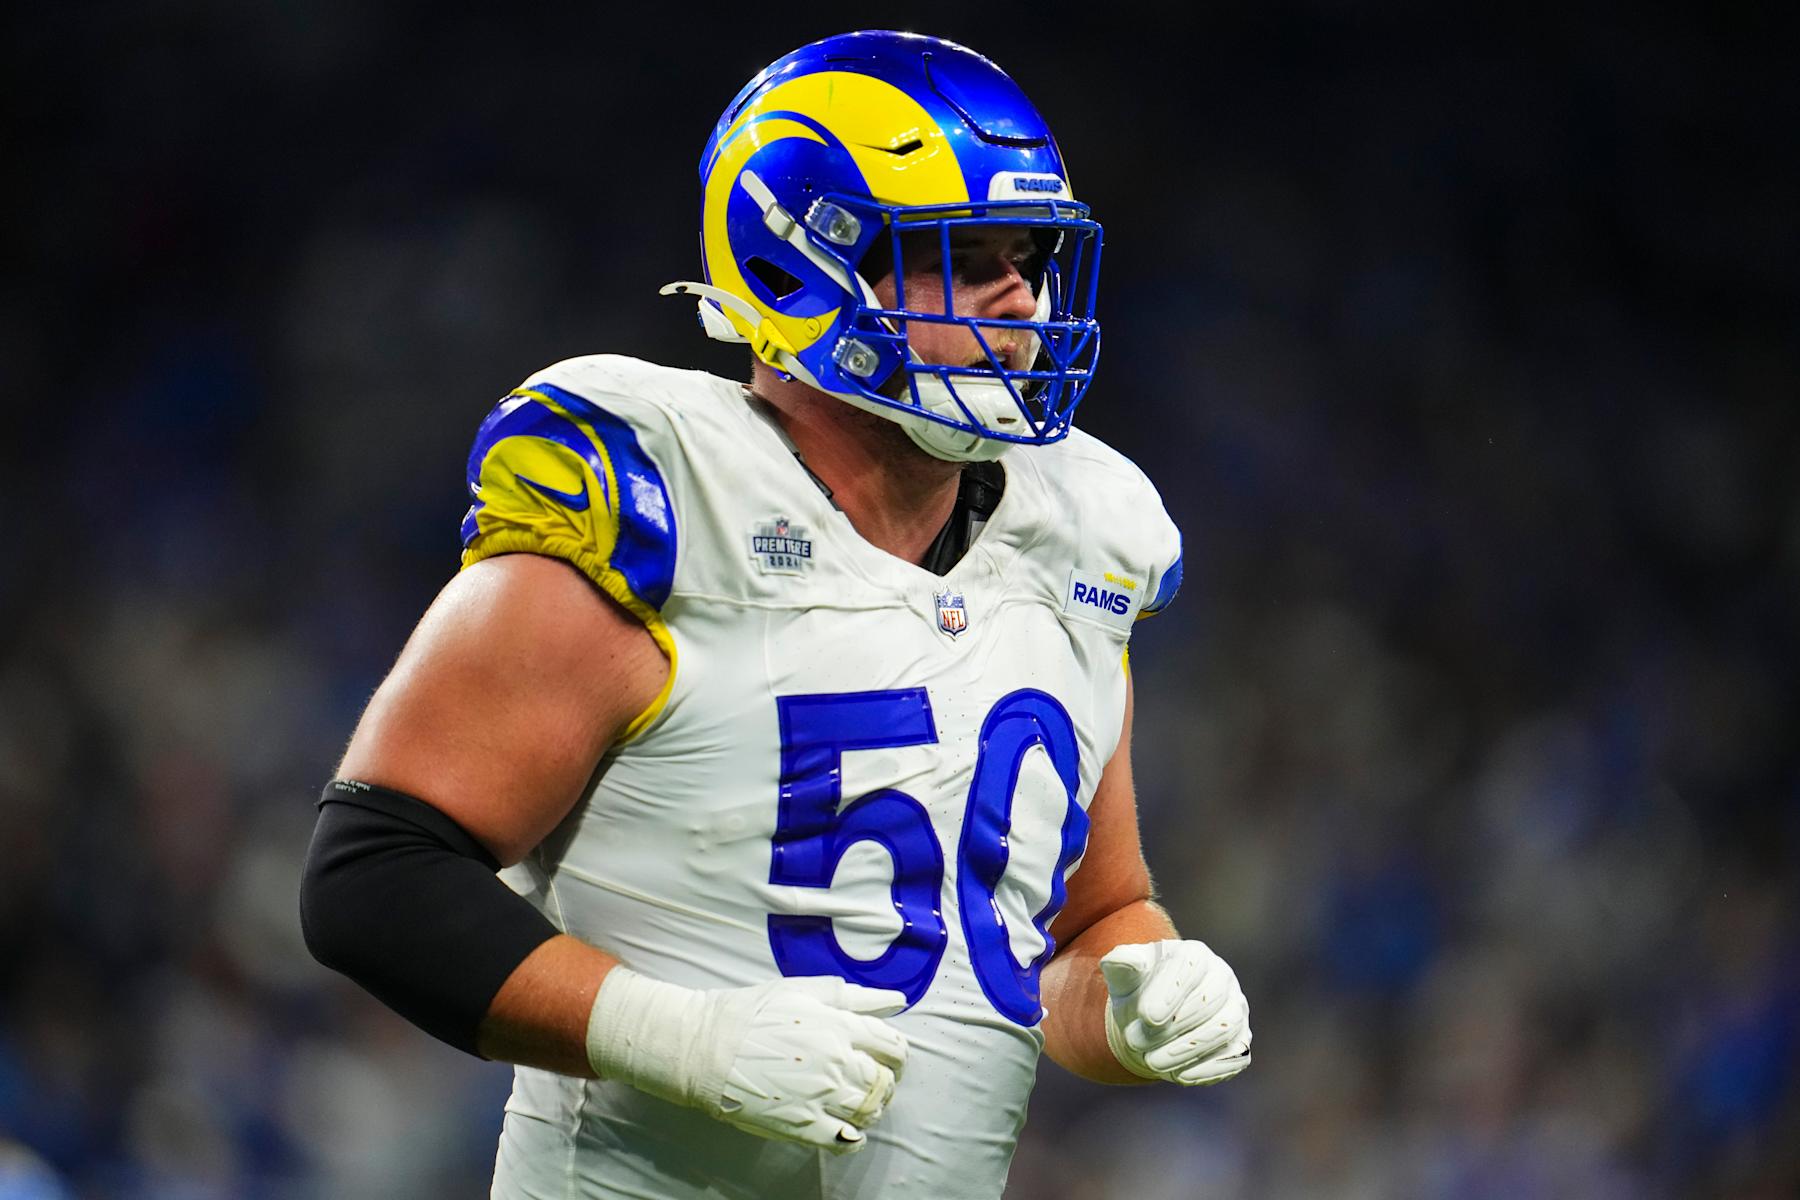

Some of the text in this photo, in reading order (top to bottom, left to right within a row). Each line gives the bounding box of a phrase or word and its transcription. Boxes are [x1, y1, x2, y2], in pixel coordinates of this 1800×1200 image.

[1014, 178, 1062, 193] RAMS
[1073, 582, 1130, 615] RAMS
[942, 610, 964, 629] NFL
[767, 686, 1091, 1027] 50
